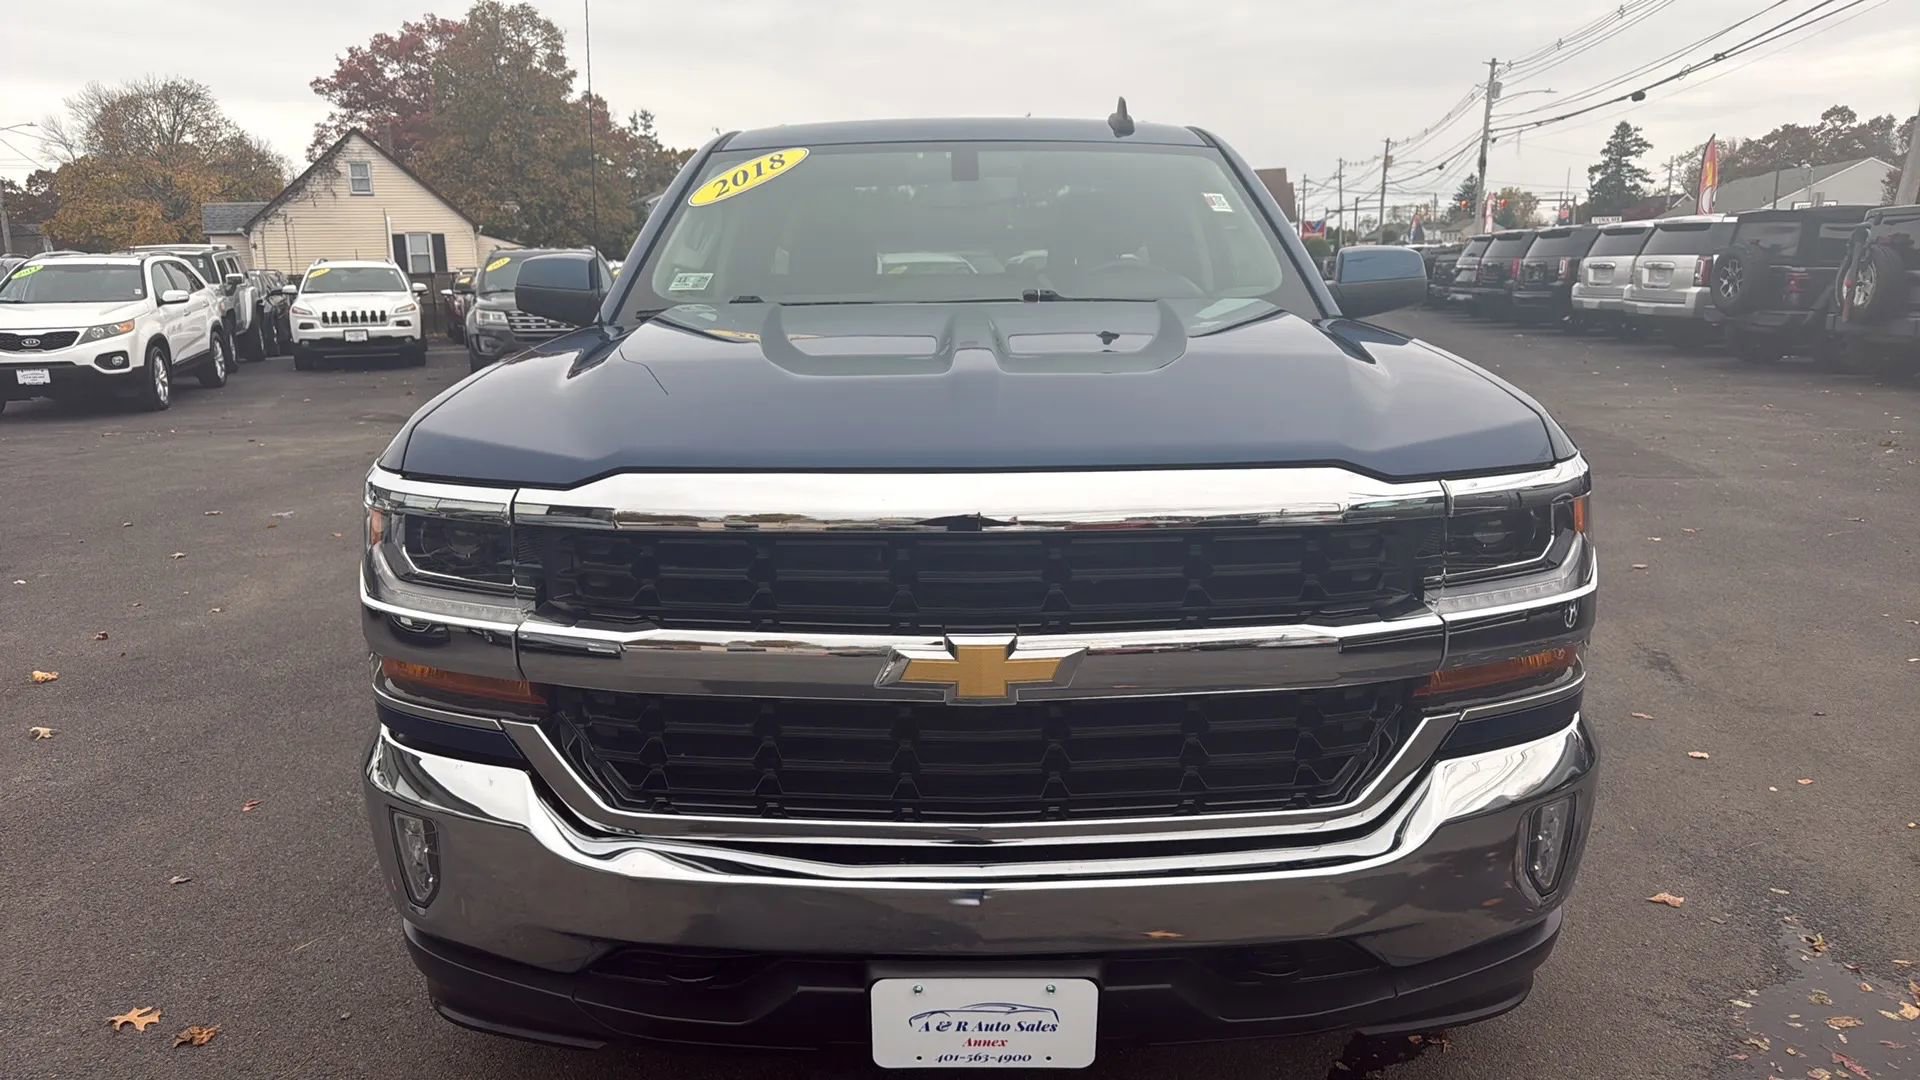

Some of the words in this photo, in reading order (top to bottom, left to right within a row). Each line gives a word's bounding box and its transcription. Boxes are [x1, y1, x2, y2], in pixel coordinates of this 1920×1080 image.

[713, 154, 786, 198] 2018
[919, 1020, 931, 1033] A
[935, 1020, 952, 1033] &
[955, 1020, 969, 1033] R
[971, 1020, 1011, 1033] Auto
[1014, 1020, 1059, 1033] Sales
[962, 1037, 1009, 1048] Annex
[934, 1053, 1032, 1064] 401-563-4900
